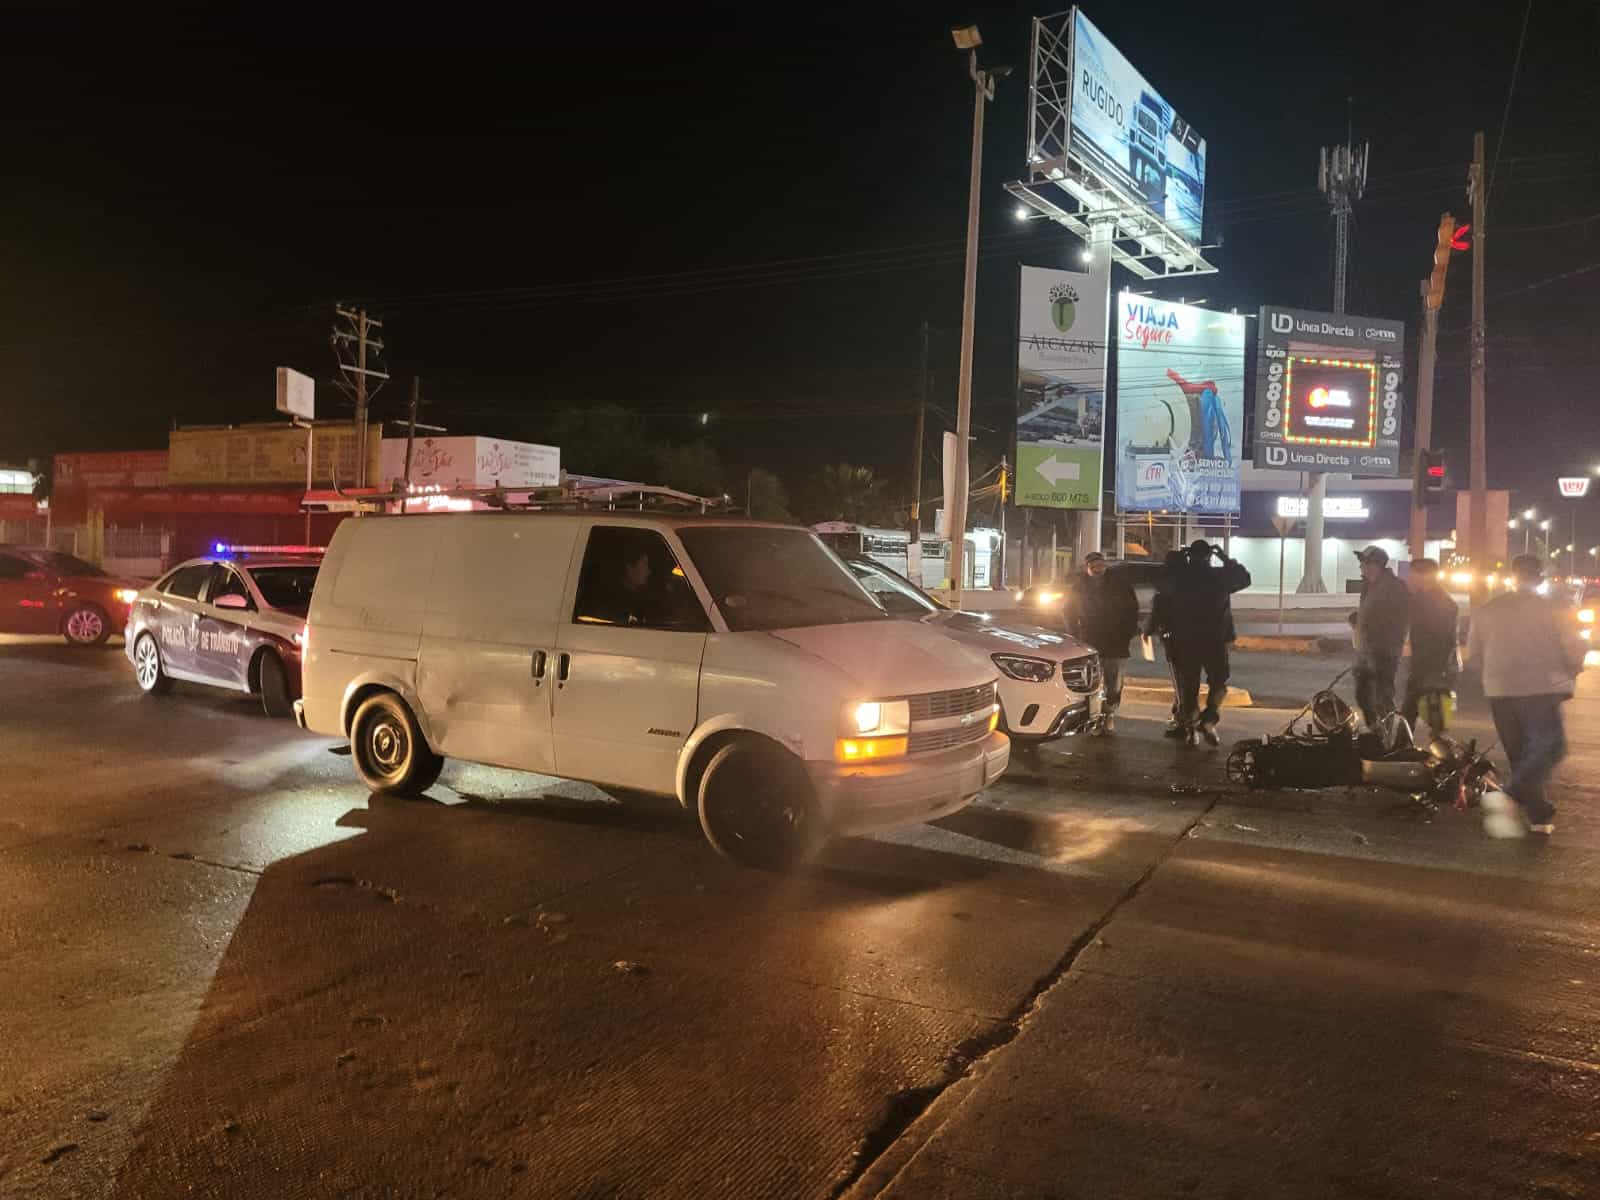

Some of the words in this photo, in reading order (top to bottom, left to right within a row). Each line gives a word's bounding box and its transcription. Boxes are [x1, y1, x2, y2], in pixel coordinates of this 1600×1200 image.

[1127, 303, 1179, 329] VIAJA
[1321, 323, 1354, 337] Directa
[1316, 453, 1350, 465] Directa
[1069, 492, 1089, 503] MTS
[201, 631, 209, 651] DE
